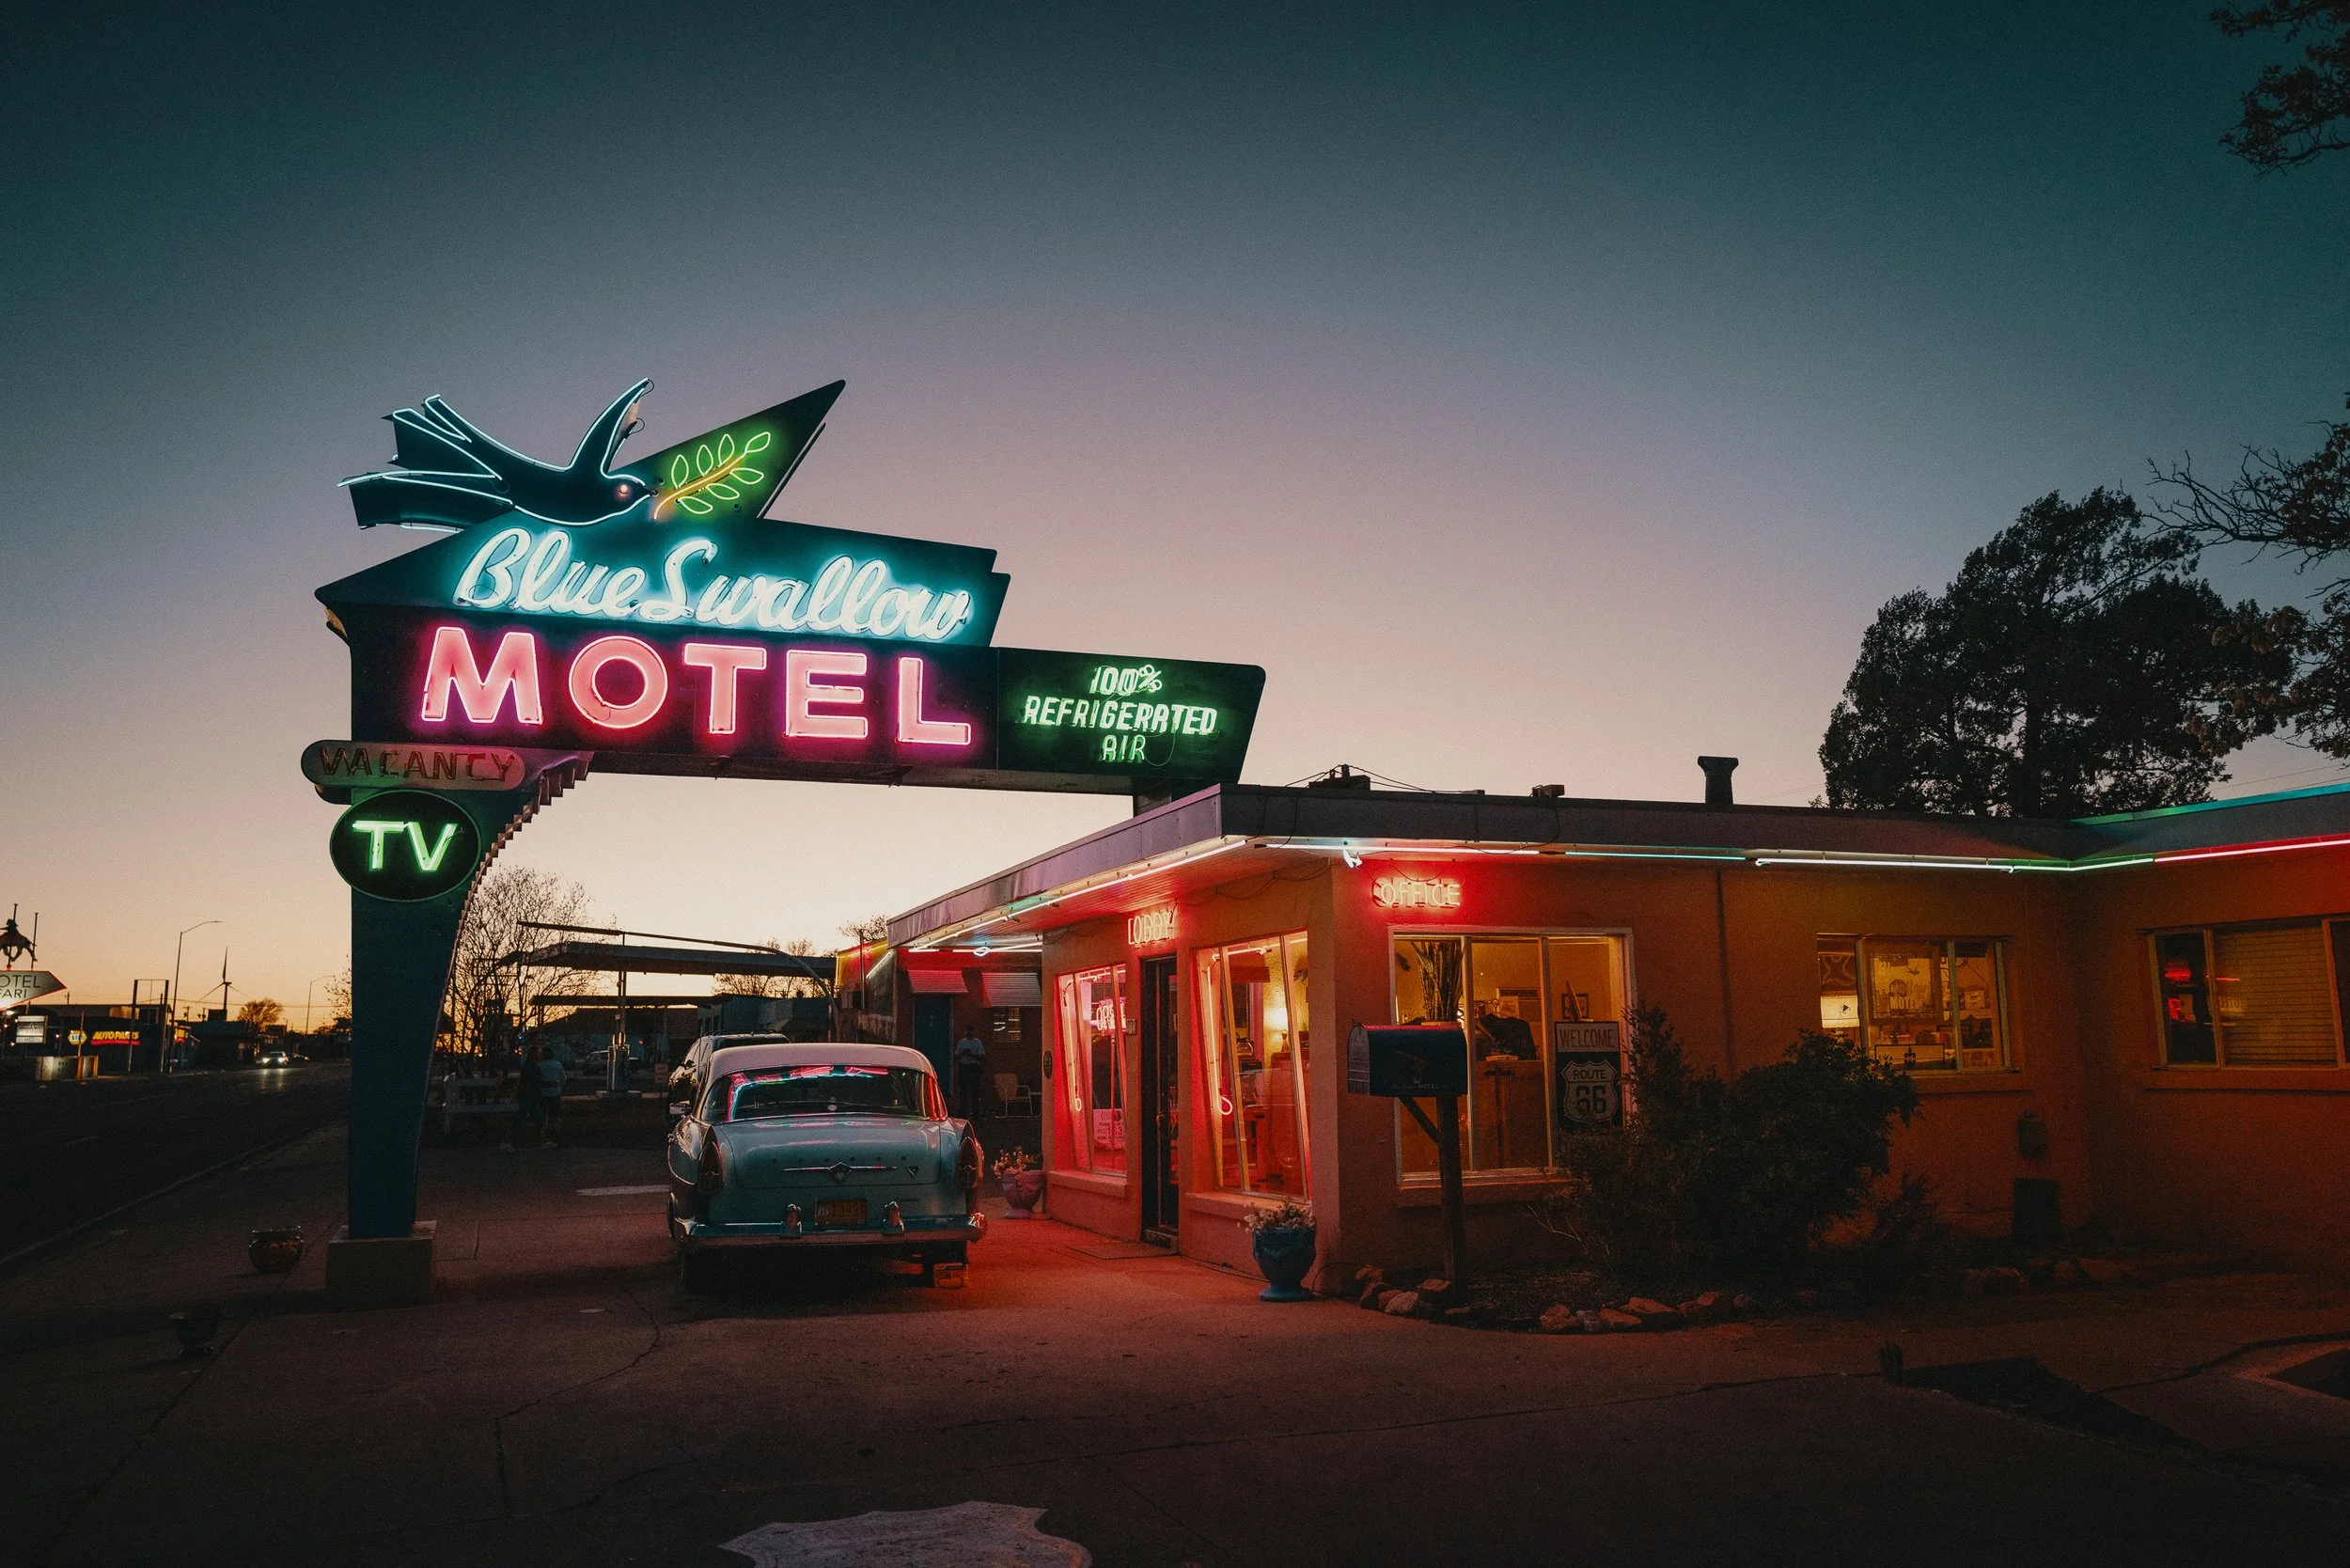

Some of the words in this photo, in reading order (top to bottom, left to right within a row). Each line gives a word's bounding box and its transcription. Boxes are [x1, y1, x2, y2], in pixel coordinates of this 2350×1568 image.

[453, 527, 645, 617] Blue
[637, 539, 971, 640] Swallow
[420, 625, 971, 745] MOTEL
[1089, 664, 1163, 697] 100%
[1023, 696, 1218, 735] REFRIGERATED
[1100, 734, 1146, 763] AIR
[352, 821, 458, 872] TV
[1374, 878, 1461, 907] OFFICE
[1127, 906, 1179, 946] LOBBY
[92, 1031, 115, 1040] AUTO
[1559, 1028, 1615, 1048] WELCOME
[1573, 1069, 1606, 1080] ROUTE
[1574, 1086, 1606, 1115] 66
